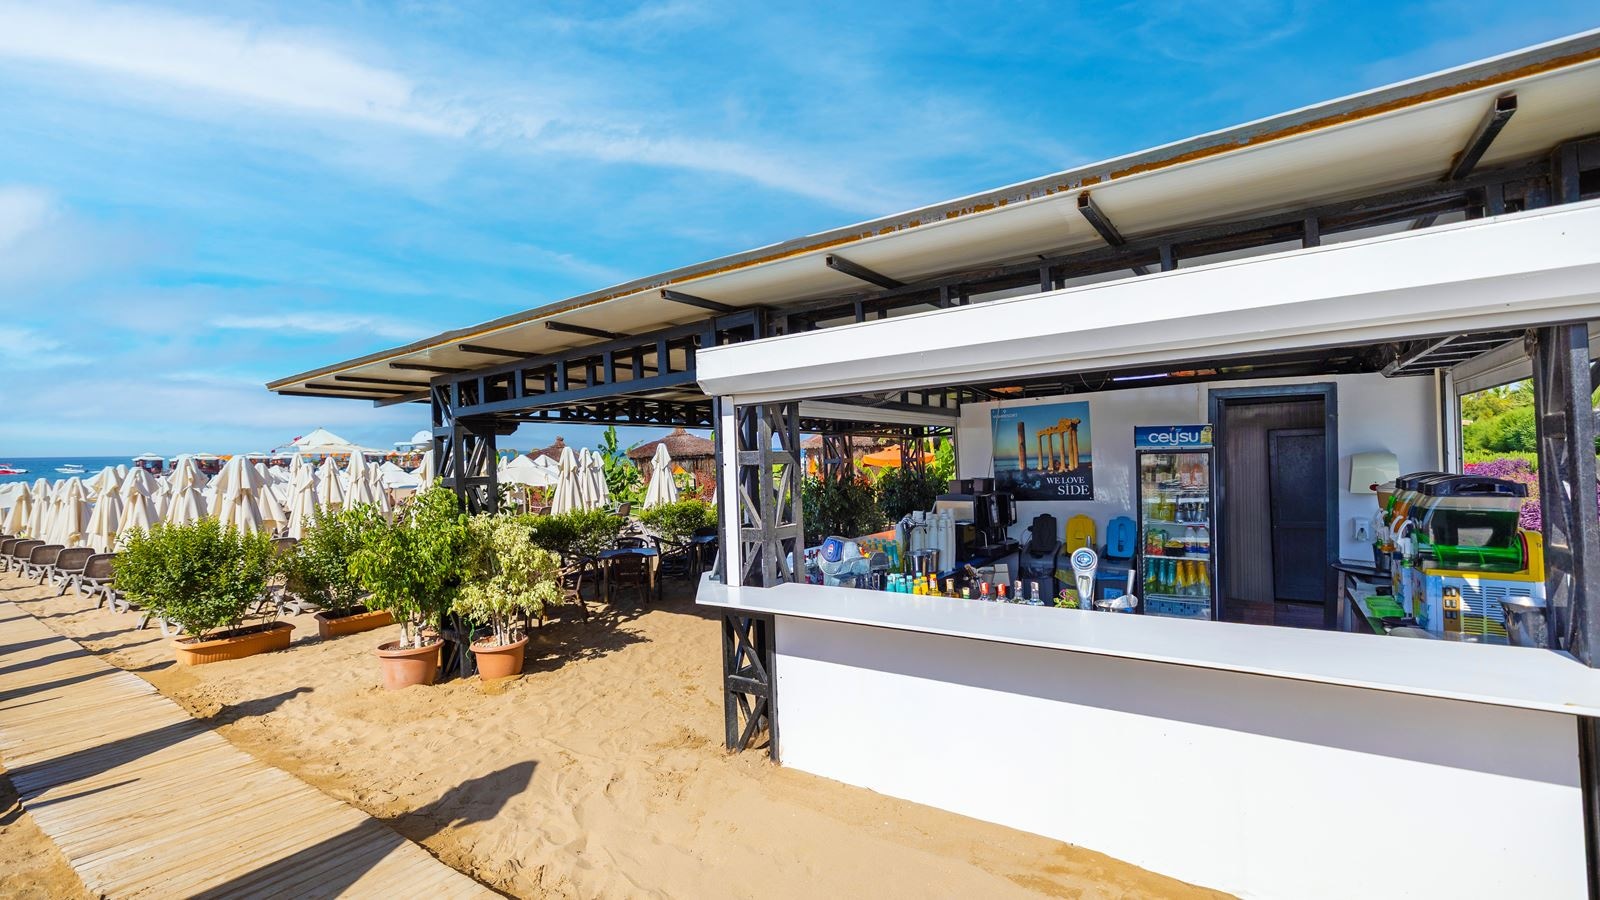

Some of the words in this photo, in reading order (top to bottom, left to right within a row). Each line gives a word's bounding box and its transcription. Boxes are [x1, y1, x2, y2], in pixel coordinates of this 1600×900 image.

[1148, 432, 1199, 446] ceysu
[1046, 476, 1061, 484] WE
[1061, 476, 1085, 484] LOVE
